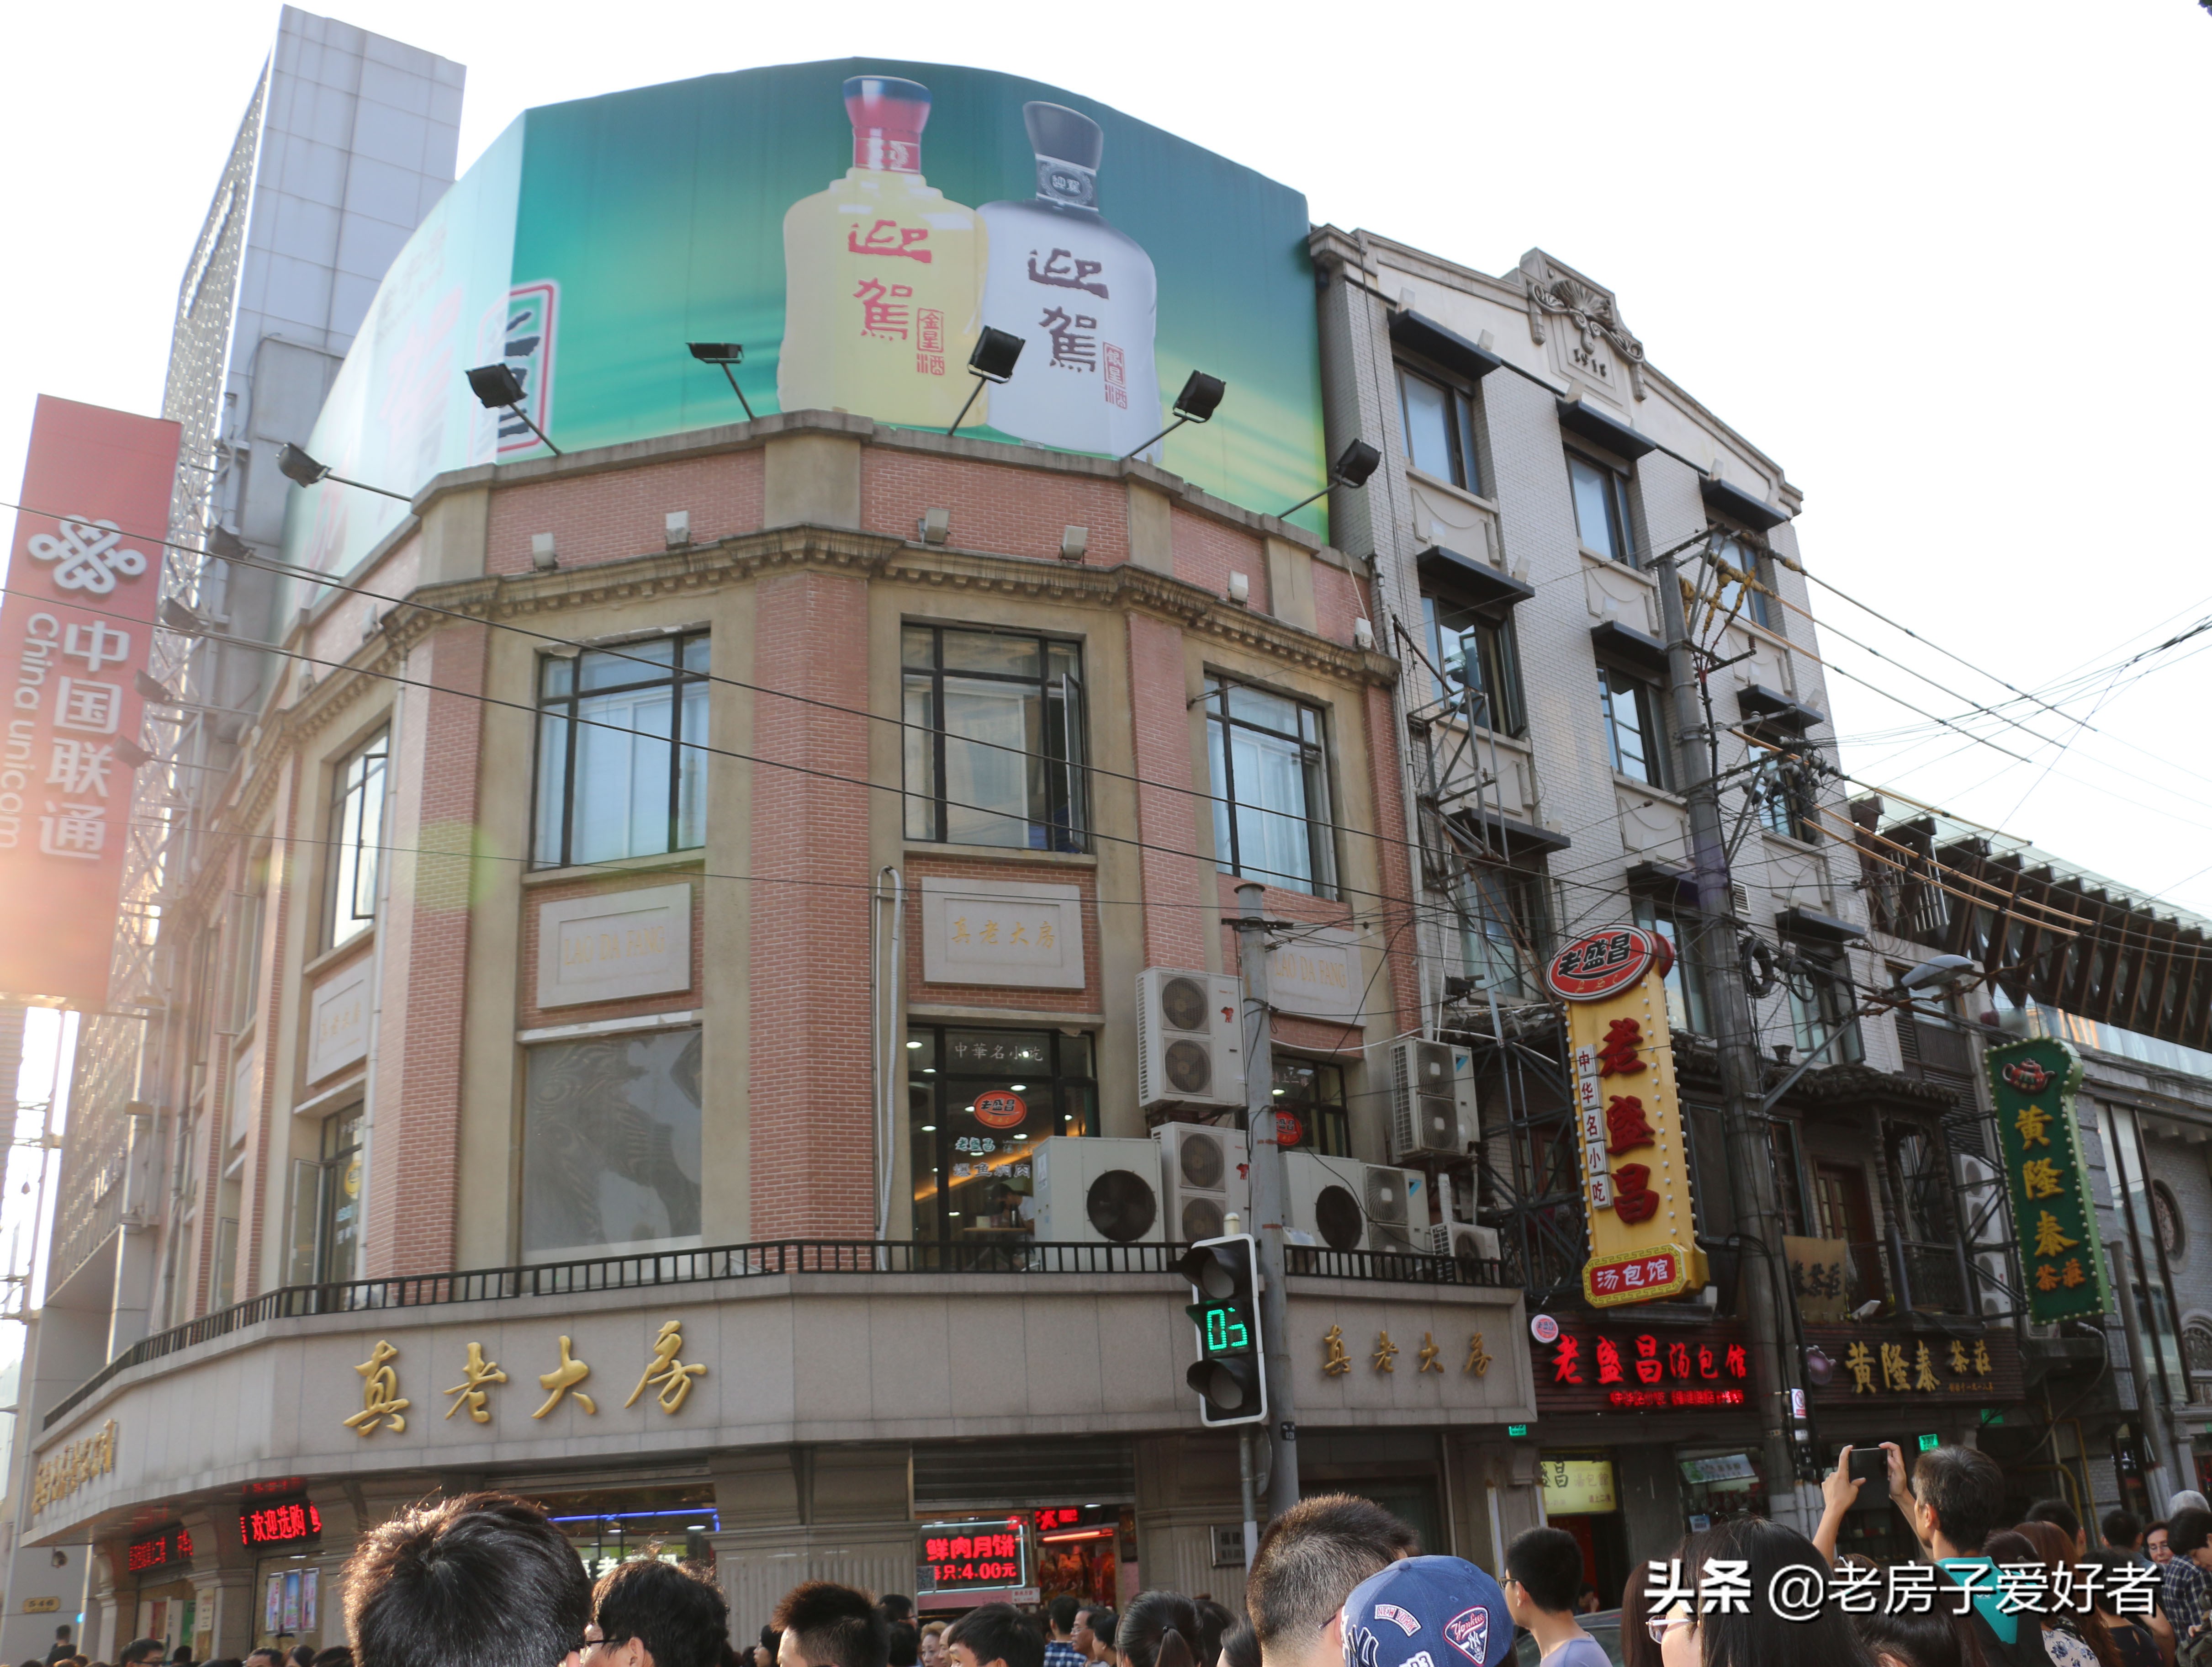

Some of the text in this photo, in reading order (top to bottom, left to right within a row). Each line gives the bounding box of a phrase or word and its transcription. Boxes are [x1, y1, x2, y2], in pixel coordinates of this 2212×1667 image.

[39, 620, 131, 860] 中国联通
[564, 926, 665, 966] LAO DA FANG
[951, 915, 1056, 950] 真老大房
[1300, 955, 1316, 982] DA
[1318, 958, 1346, 988] FANG
[1557, 932, 1631, 977] 老盛昌
[955, 1041, 1043, 1061] 中華名小吃
[1578, 1050, 1606, 1204] 中华名小吃
[1596, 1017, 1660, 1225] 老盛昌
[2014, 1104, 2080, 1257] 黄隆泰
[1596, 1258, 1668, 1291] 汤包馆
[1323, 1323, 1493, 1378] 真老大房
[343, 1319, 708, 1437] 真老大房
[250, 1504, 307, 1541] 欢迎选购
[926, 1534, 1016, 1561] 鲜肉月饼
[1377, 1606, 1418, 1632] NEW YORK
